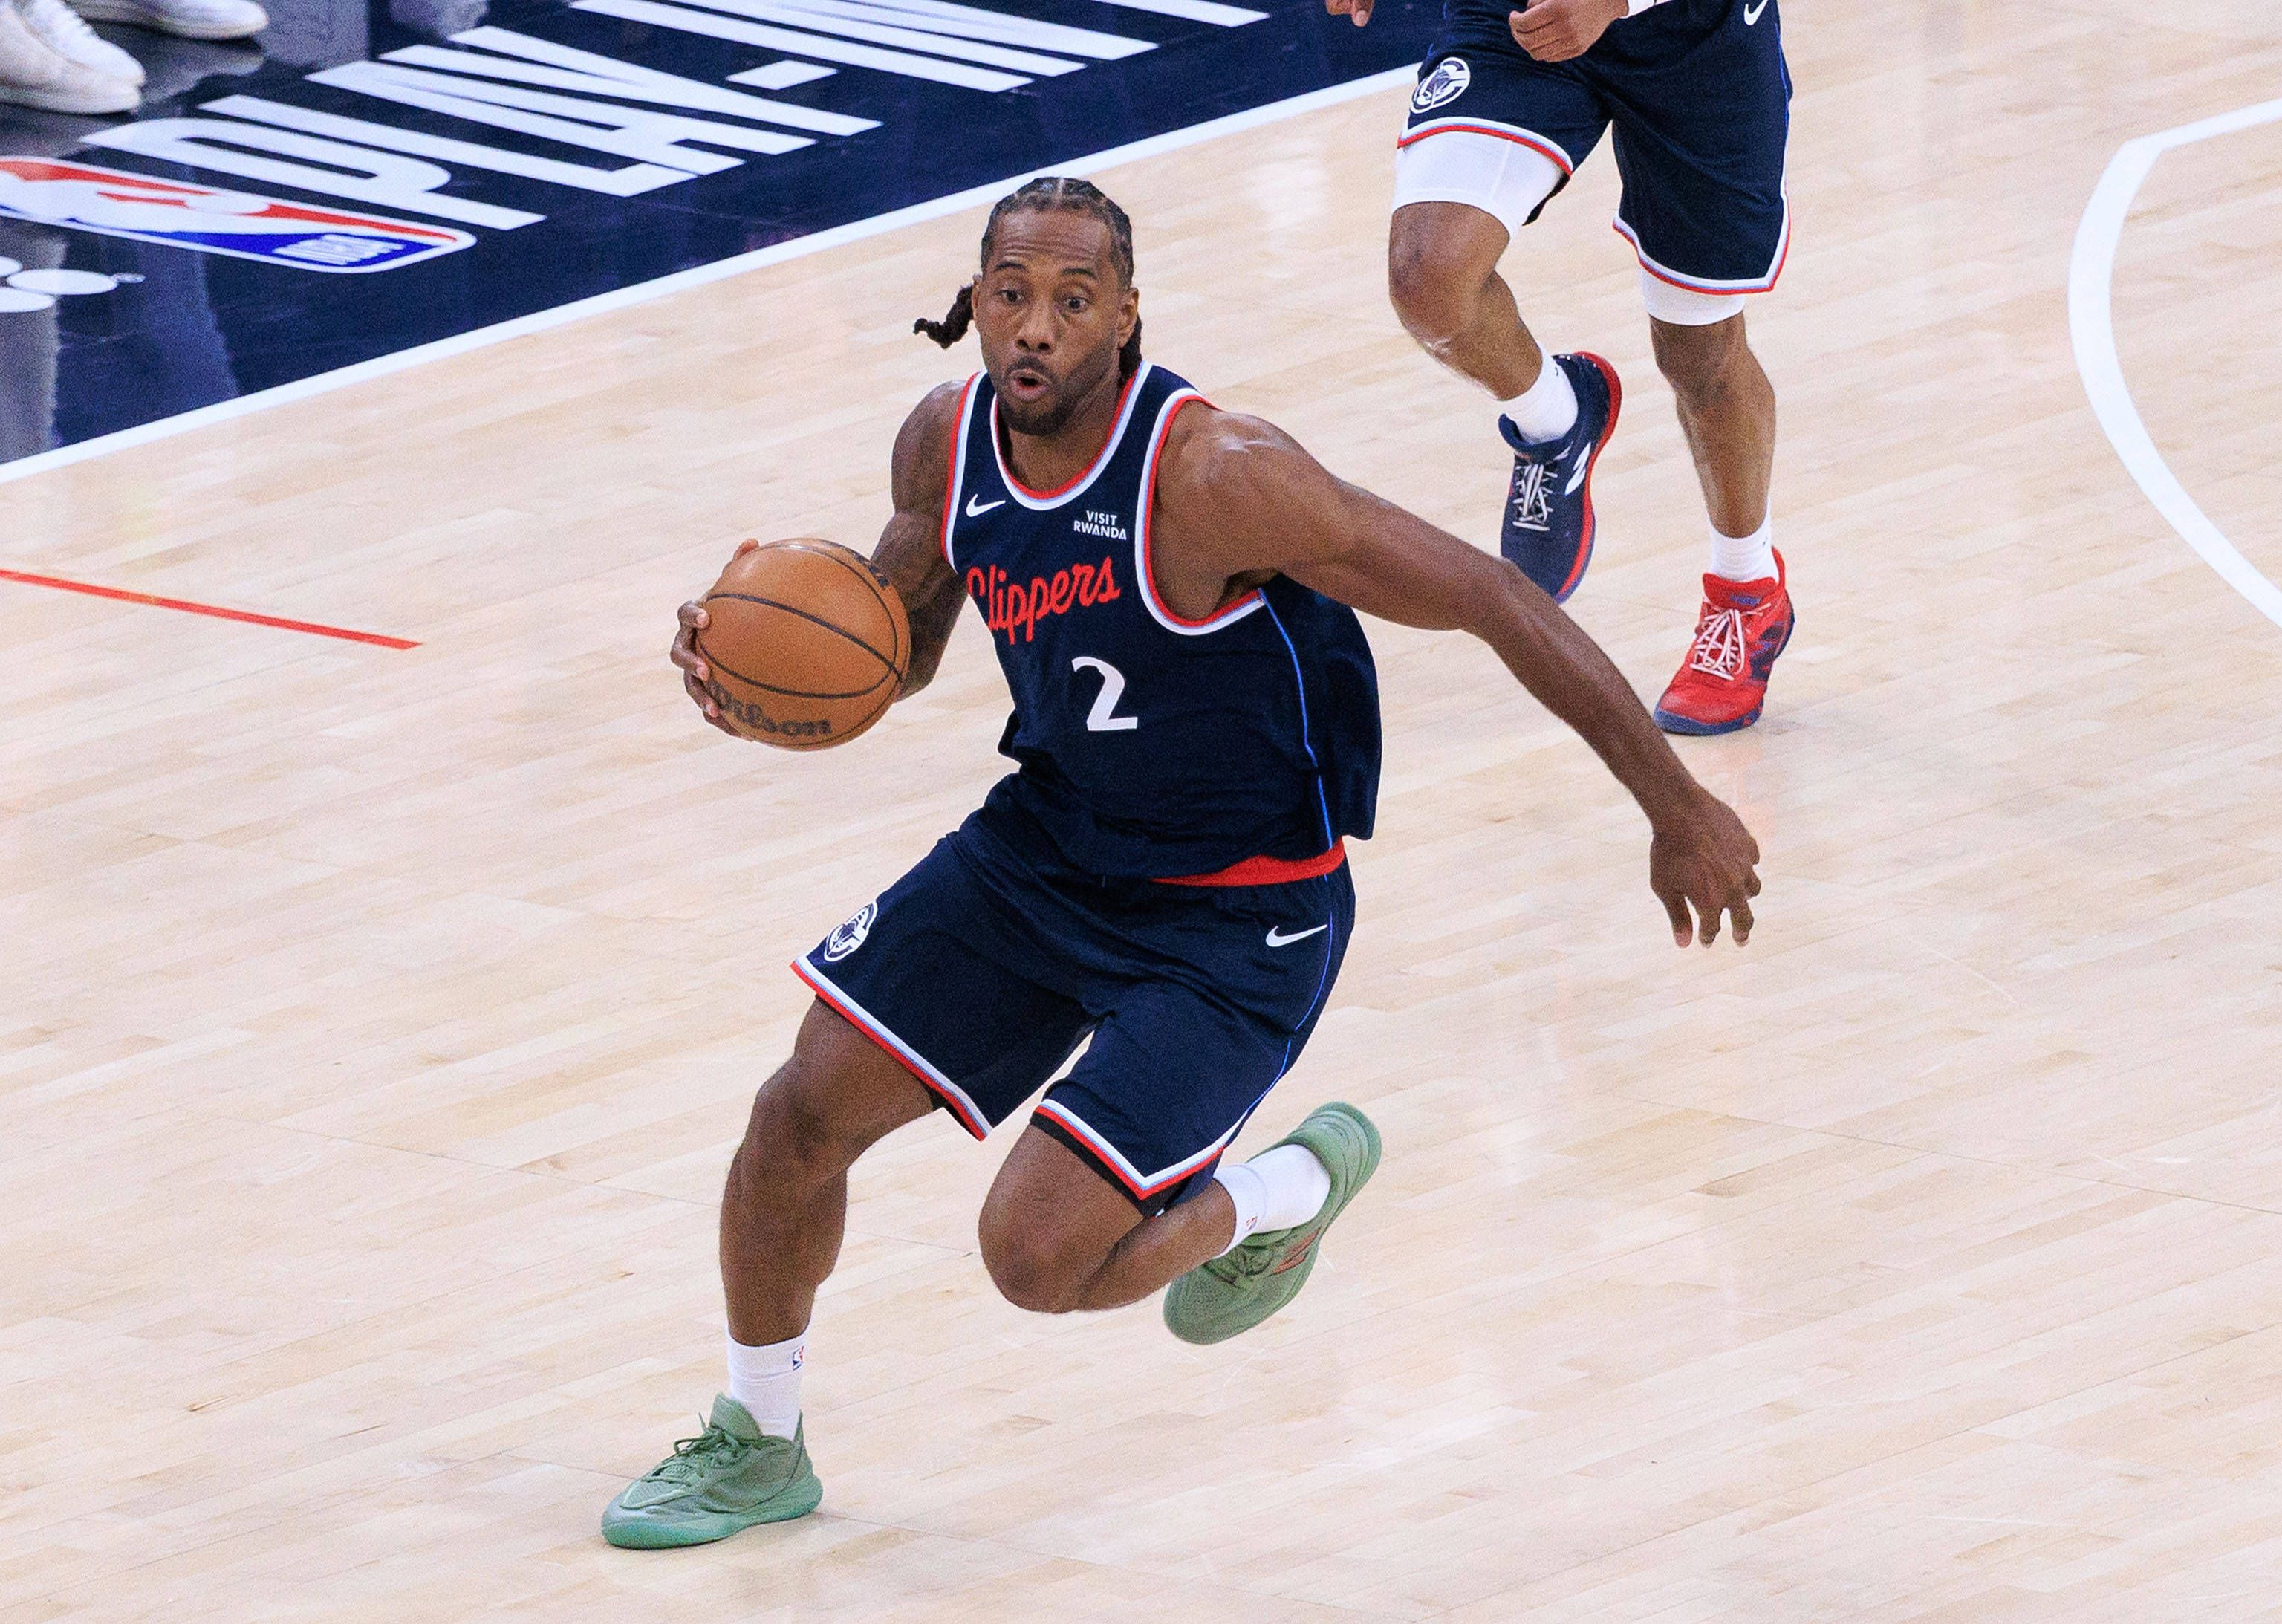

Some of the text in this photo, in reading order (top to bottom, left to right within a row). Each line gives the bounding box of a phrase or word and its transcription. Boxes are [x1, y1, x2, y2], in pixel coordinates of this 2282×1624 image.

[1086, 510, 1118, 526] VISIT
[1073, 520, 1127, 541] RWANDA
[1071, 656, 1138, 731] 2
